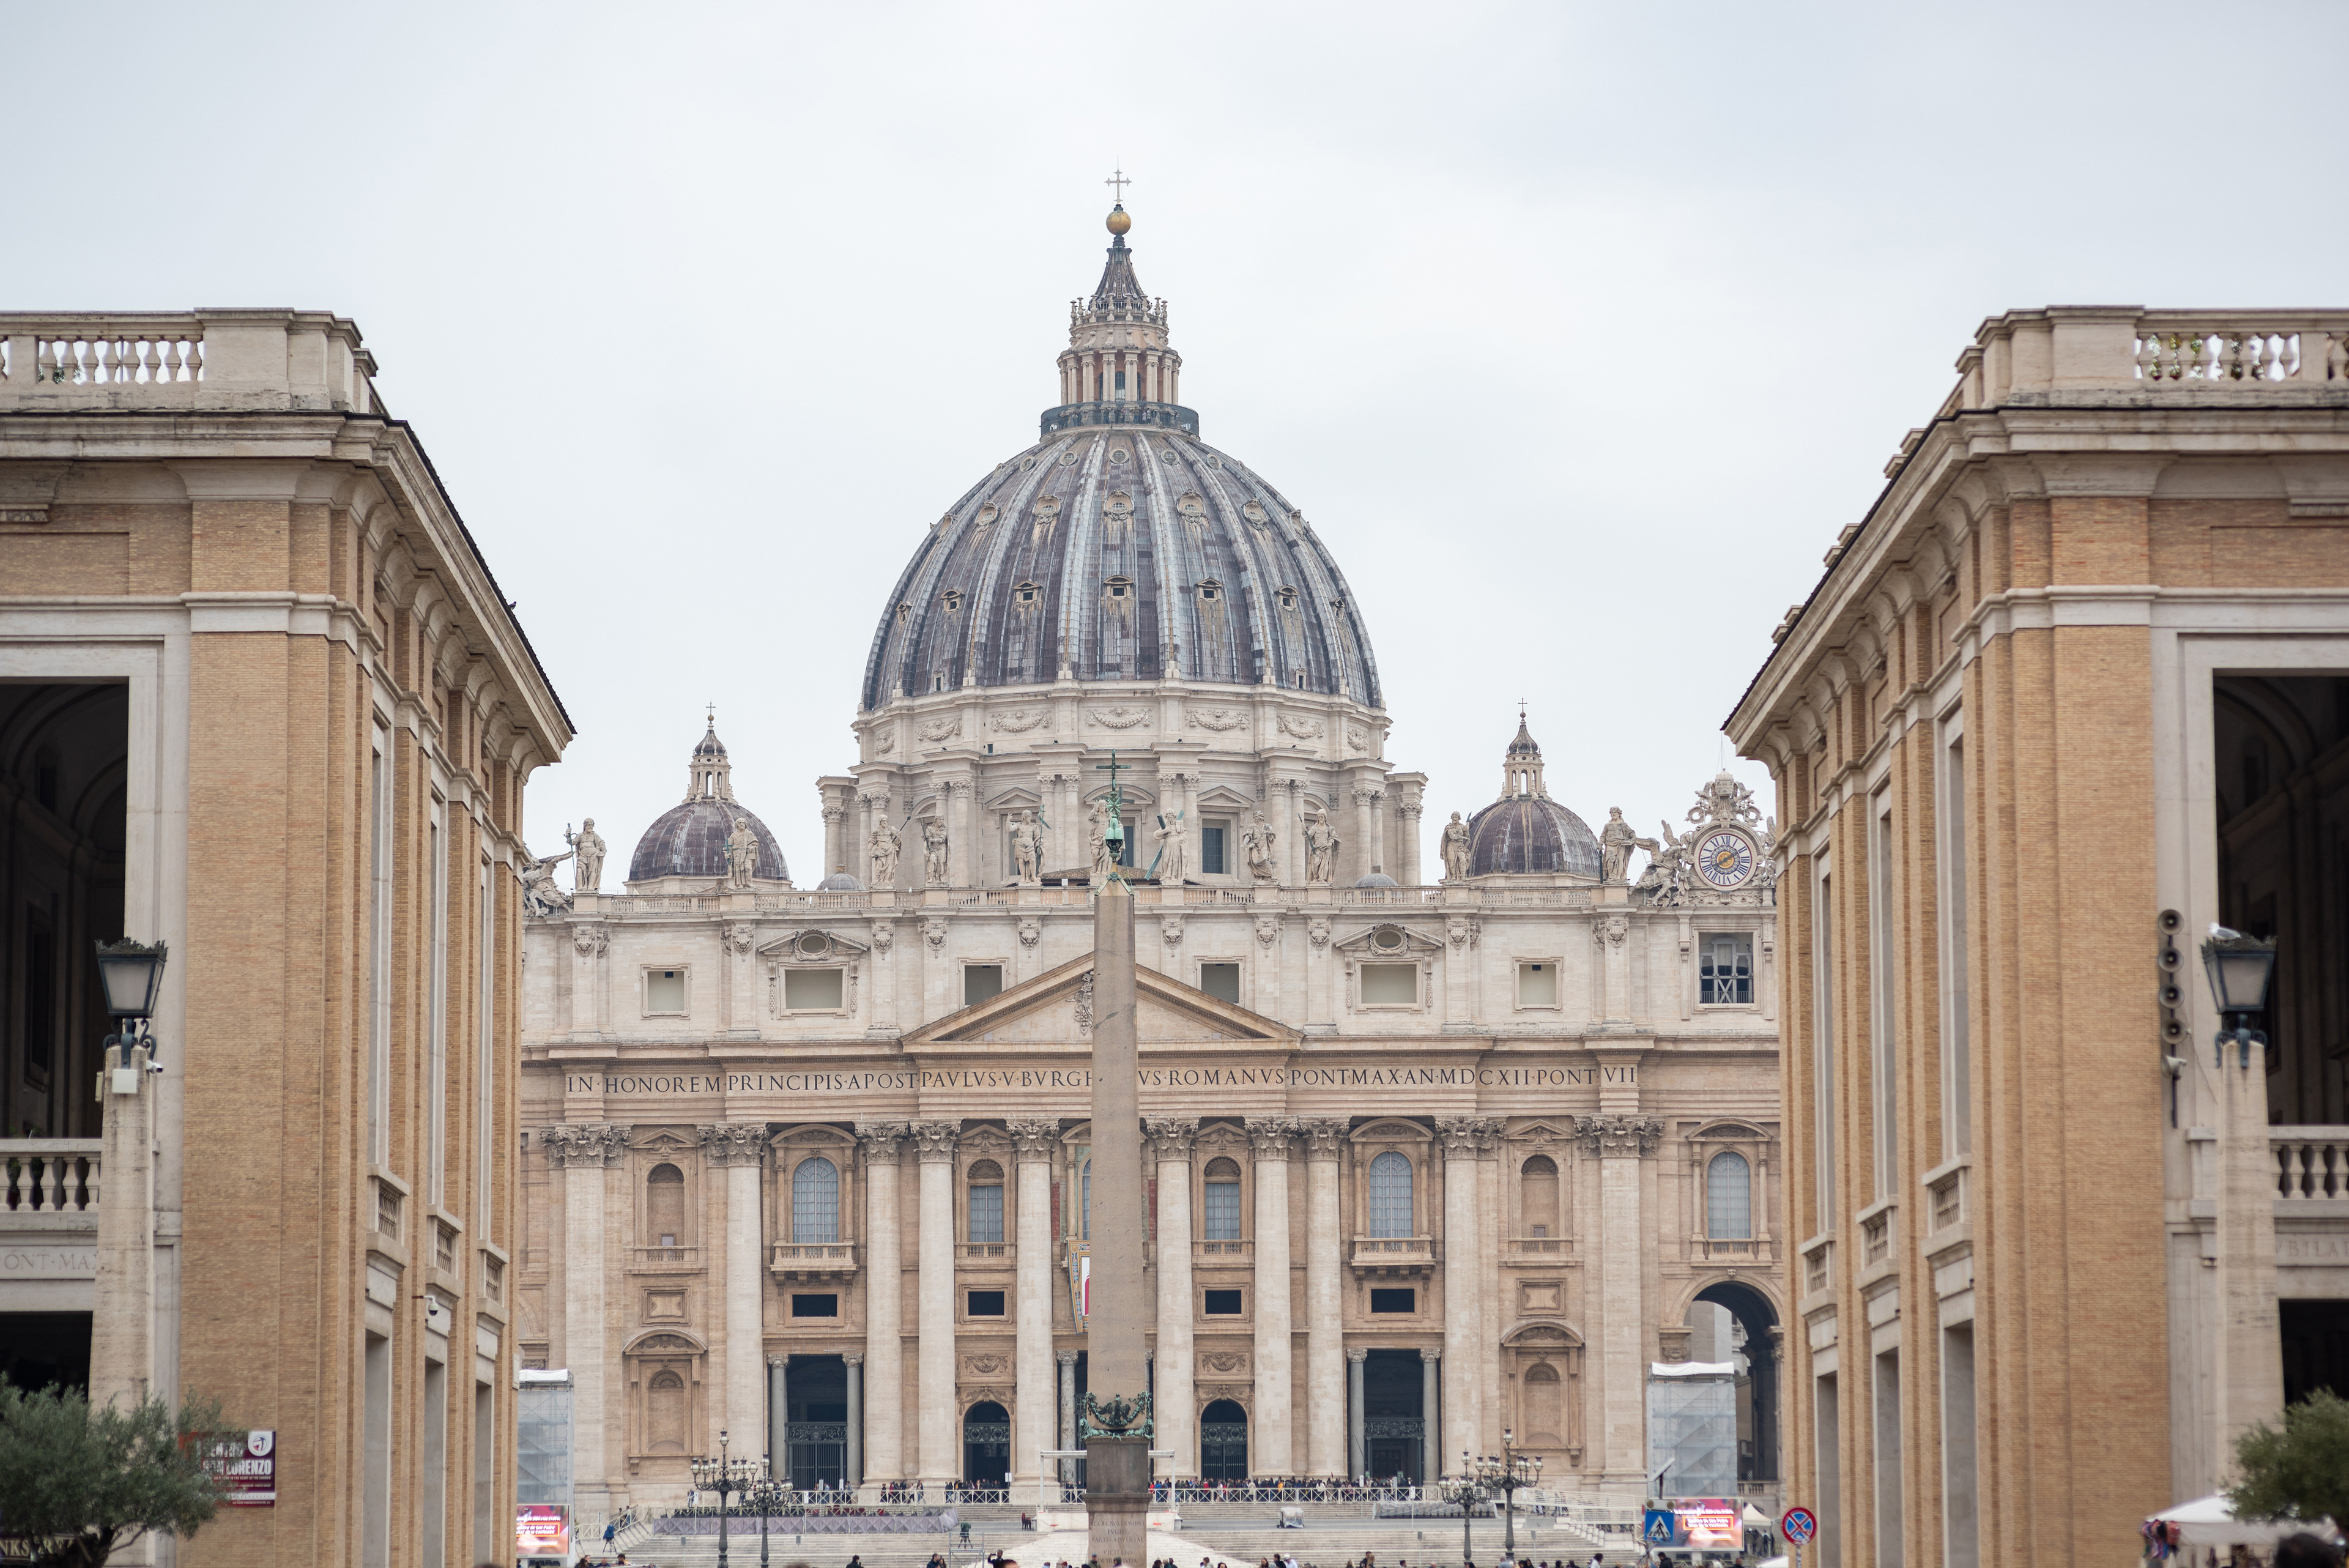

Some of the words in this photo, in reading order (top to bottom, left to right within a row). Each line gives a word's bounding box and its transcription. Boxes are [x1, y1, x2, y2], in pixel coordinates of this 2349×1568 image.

[568, 1076, 593, 1092] IN
[604, 1077, 721, 1093] HONOREM
[727, 1074, 843, 1091] PRINCIPIS
[847, 1072, 918, 1090] APOST
[921, 1071, 996, 1087] PAVLVS
[1001, 1071, 1014, 1087] V
[1169, 1068, 1284, 1085] ROMANVS
[1290, 1069, 1349, 1085] PONT
[1351, 1069, 1400, 1085] MAX
[1403, 1069, 1434, 1085] AN
[1439, 1069, 1529, 1085] MDCXII
[1537, 1068, 1596, 1085] PONT
[1603, 1067, 1635, 1083] VII
[226, 1460, 272, 1476] LORENZO
